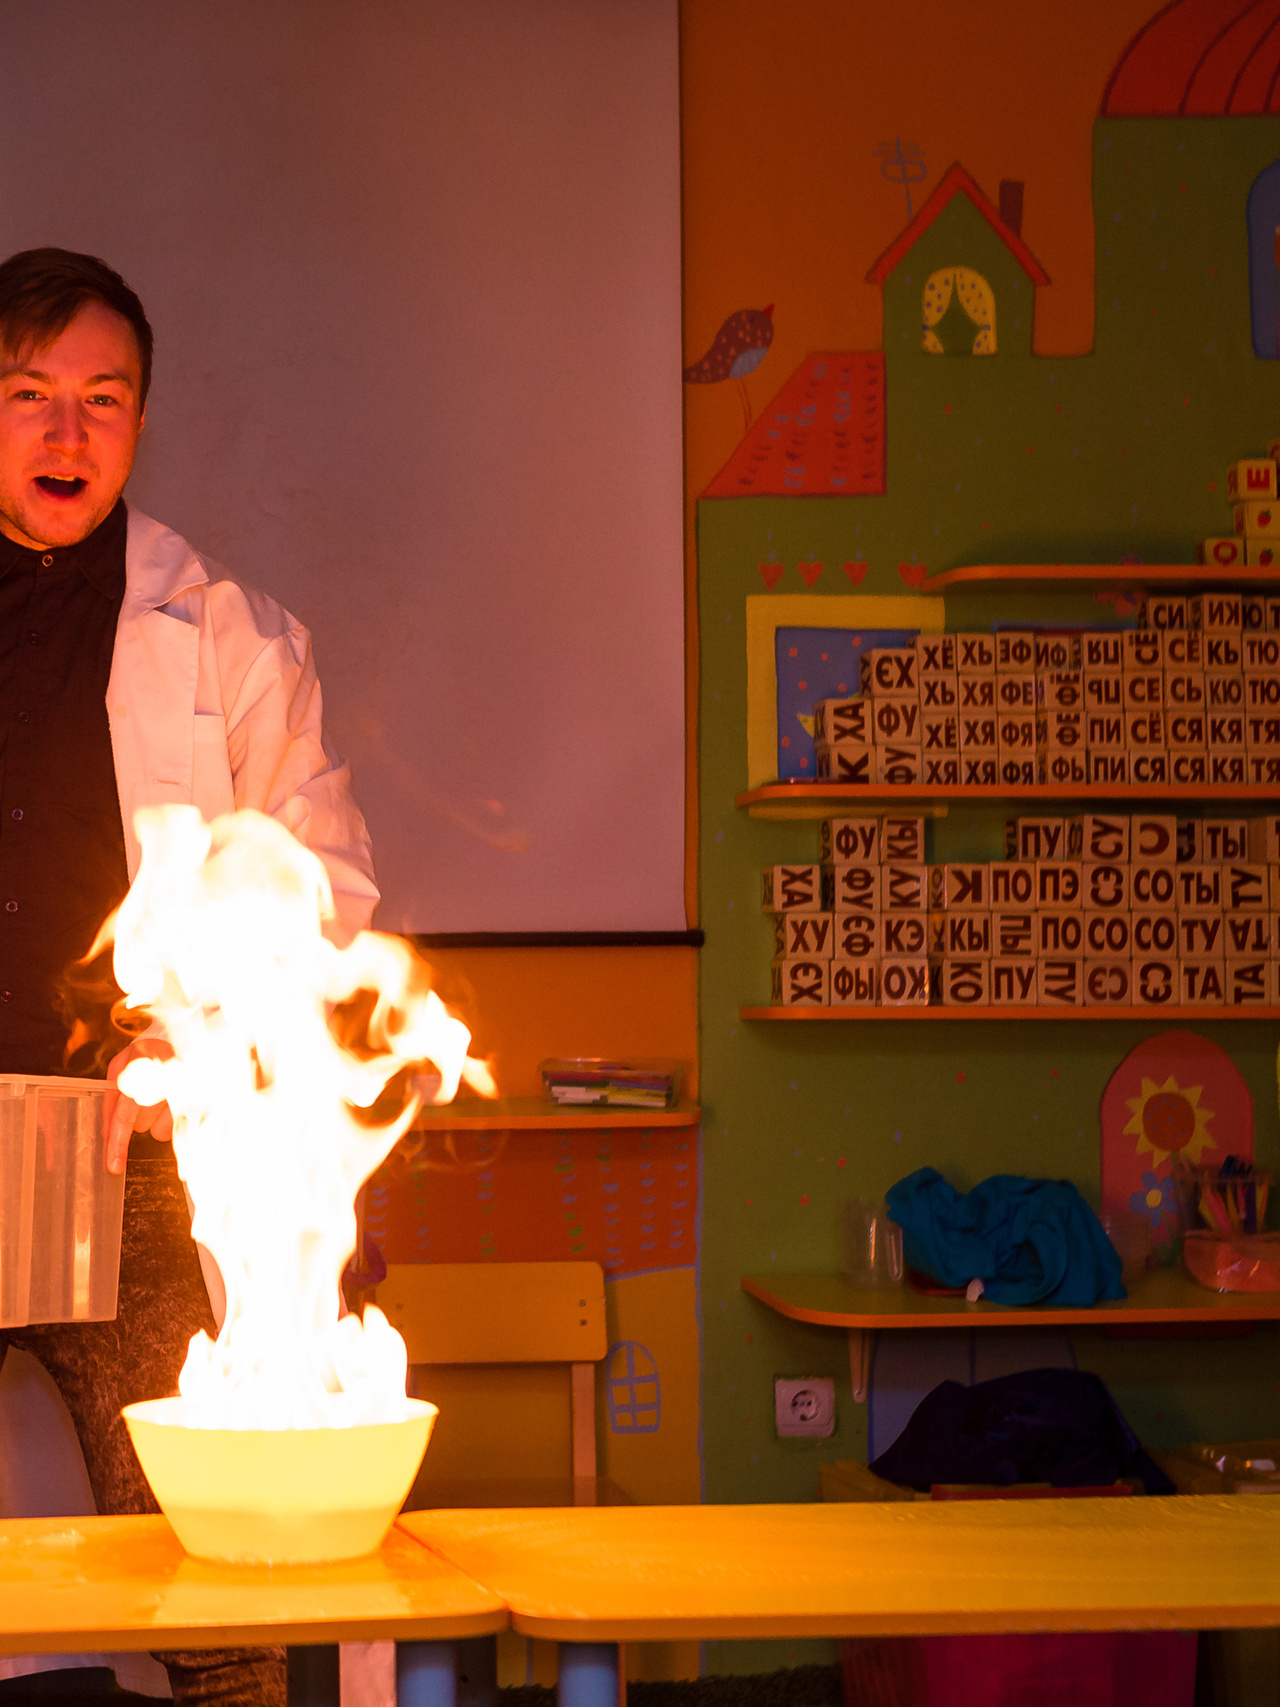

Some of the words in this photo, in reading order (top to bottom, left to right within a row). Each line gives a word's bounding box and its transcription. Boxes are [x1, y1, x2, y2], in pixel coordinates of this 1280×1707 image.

[1153, 604, 1185, 630] СИ
[923, 639, 955, 671] ХЁ
[962, 639, 993, 666] ХЬ
[1168, 631, 1200, 663] СЁ
[1208, 640, 1239, 666] КЬ
[1246, 639, 1279, 665] ТЮ
[924, 681, 955, 706] ХЬ
[963, 681, 994, 707] ХЯ
[1128, 676, 1161, 704] СЕ
[1170, 676, 1202, 702] СЬ
[1209, 679, 1242, 701] КЮ
[833, 701, 865, 743] ХА
[877, 703, 918, 737] ФУ
[925, 717, 957, 749] ХЁ
[964, 719, 995, 746] ХЯ
[1001, 720, 1033, 748] ФЯ
[1090, 720, 1121, 744] ПИ
[1130, 713, 1161, 744] СЁ
[1171, 717, 1203, 743] СЯ
[1212, 717, 1242, 743] КЯ
[926, 760, 958, 785] ХЯ
[965, 760, 996, 785] ХЯ
[1002, 758, 1034, 785] ФЯ
[1051, 756, 1084, 782] ФЬ
[1094, 756, 1125, 782] ПИ
[1133, 756, 1166, 783] СЯ
[1174, 757, 1205, 783] СЯ
[1213, 757, 1244, 782] КЯ
[836, 825, 875, 859] ФУ
[887, 820, 918, 860] КЫ
[1022, 825, 1061, 859] ПУ
[1090, 818, 1124, 860] СУ
[1207, 827, 1246, 859] ТЫ
[889, 867, 921, 909] КУ
[992, 869, 1032, 903] ПО
[1039, 868, 1079, 902] ПЭ
[1134, 869, 1174, 903] СО
[1180, 872, 1220, 905] ТЫ
[790, 919, 829, 953] ХУ
[885, 919, 924, 952] КЭ
[950, 918, 988, 952] КЫ
[1041, 917, 1081, 950] ПО
[1088, 917, 1128, 951] СО
[1134, 917, 1175, 951] СО
[1181, 919, 1220, 952] ТУ
[833, 966, 874, 1000] ФЫ
[994, 966, 1035, 1000] ПУ
[1183, 966, 1221, 1000] ТА
[1234, 962, 1266, 1004] ТА
